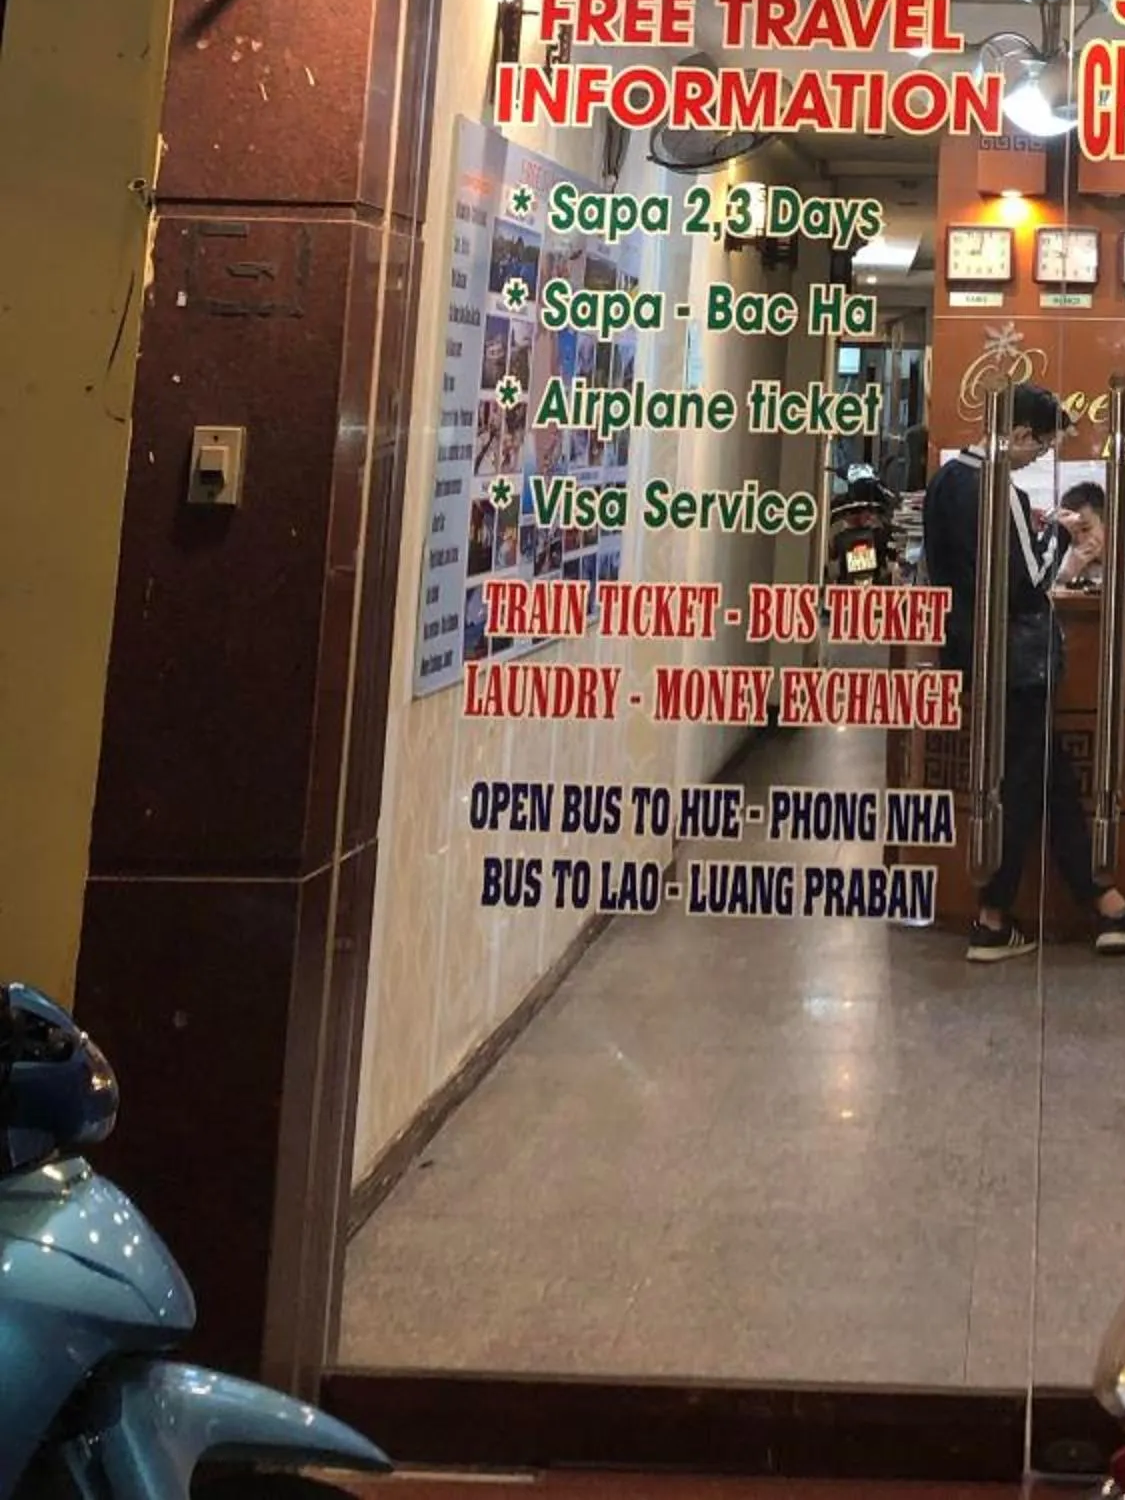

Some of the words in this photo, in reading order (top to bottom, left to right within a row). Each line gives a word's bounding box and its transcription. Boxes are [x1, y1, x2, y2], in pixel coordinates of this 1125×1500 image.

[495, 64, 1004, 134] INFORMATION
[549, 183, 670, 245] Sapa
[683, 186, 752, 242] 2,3
[766, 189, 883, 254] Days
[542, 281, 662, 339] Sapa
[706, 284, 800, 333] Bac
[809, 284, 876, 334] Ha
[533, 378, 737, 439] Airplane
[748, 380, 882, 435] ticket
[531, 477, 629, 529] Visa
[643, 478, 818, 533] Service
[483, 579, 590, 639] TRAIN
[597, 581, 721, 641] TICKET
[747, 583, 817, 642] BUS
[824, 583, 953, 646] TICKET
[463, 663, 623, 718] LAUNDRY
[653, 666, 776, 726] MONEY
[777, 667, 963, 730] EXCHANGE
[469, 781, 554, 832] OPEN
[560, 784, 623, 835] BUS
[631, 787, 670, 838] TO
[678, 788, 742, 840] HUE
[768, 789, 877, 843] PHONG
[885, 790, 956, 847] NHA
[480, 857, 542, 908] BUS
[552, 859, 591, 910] TO
[599, 860, 660, 913] LAO
[687, 862, 794, 917] LUANG
[802, 864, 937, 923] PRABAN
